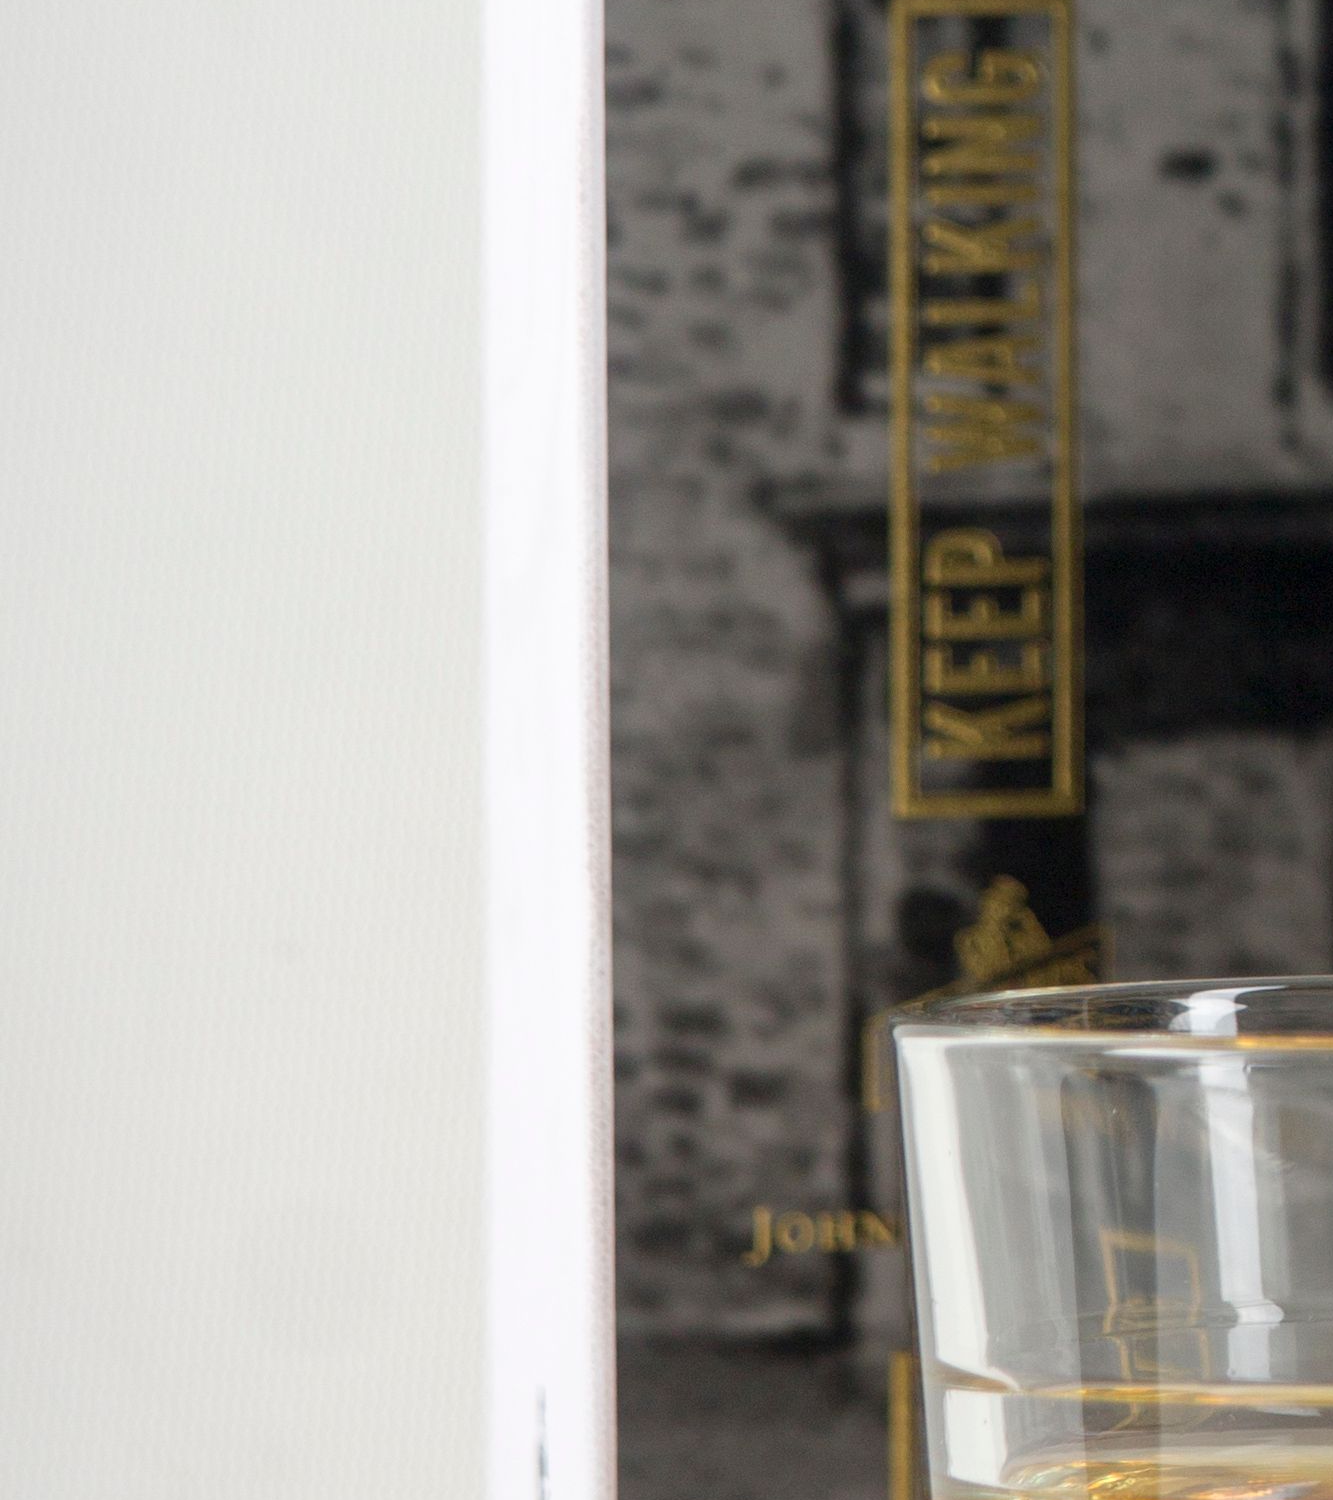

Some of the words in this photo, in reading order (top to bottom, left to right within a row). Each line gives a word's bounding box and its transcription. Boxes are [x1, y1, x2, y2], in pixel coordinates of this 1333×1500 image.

[922, 48, 1045, 474] WALKING
[925, 525, 1050, 761] KEEP
[740, 1204, 897, 1268] JOHN
